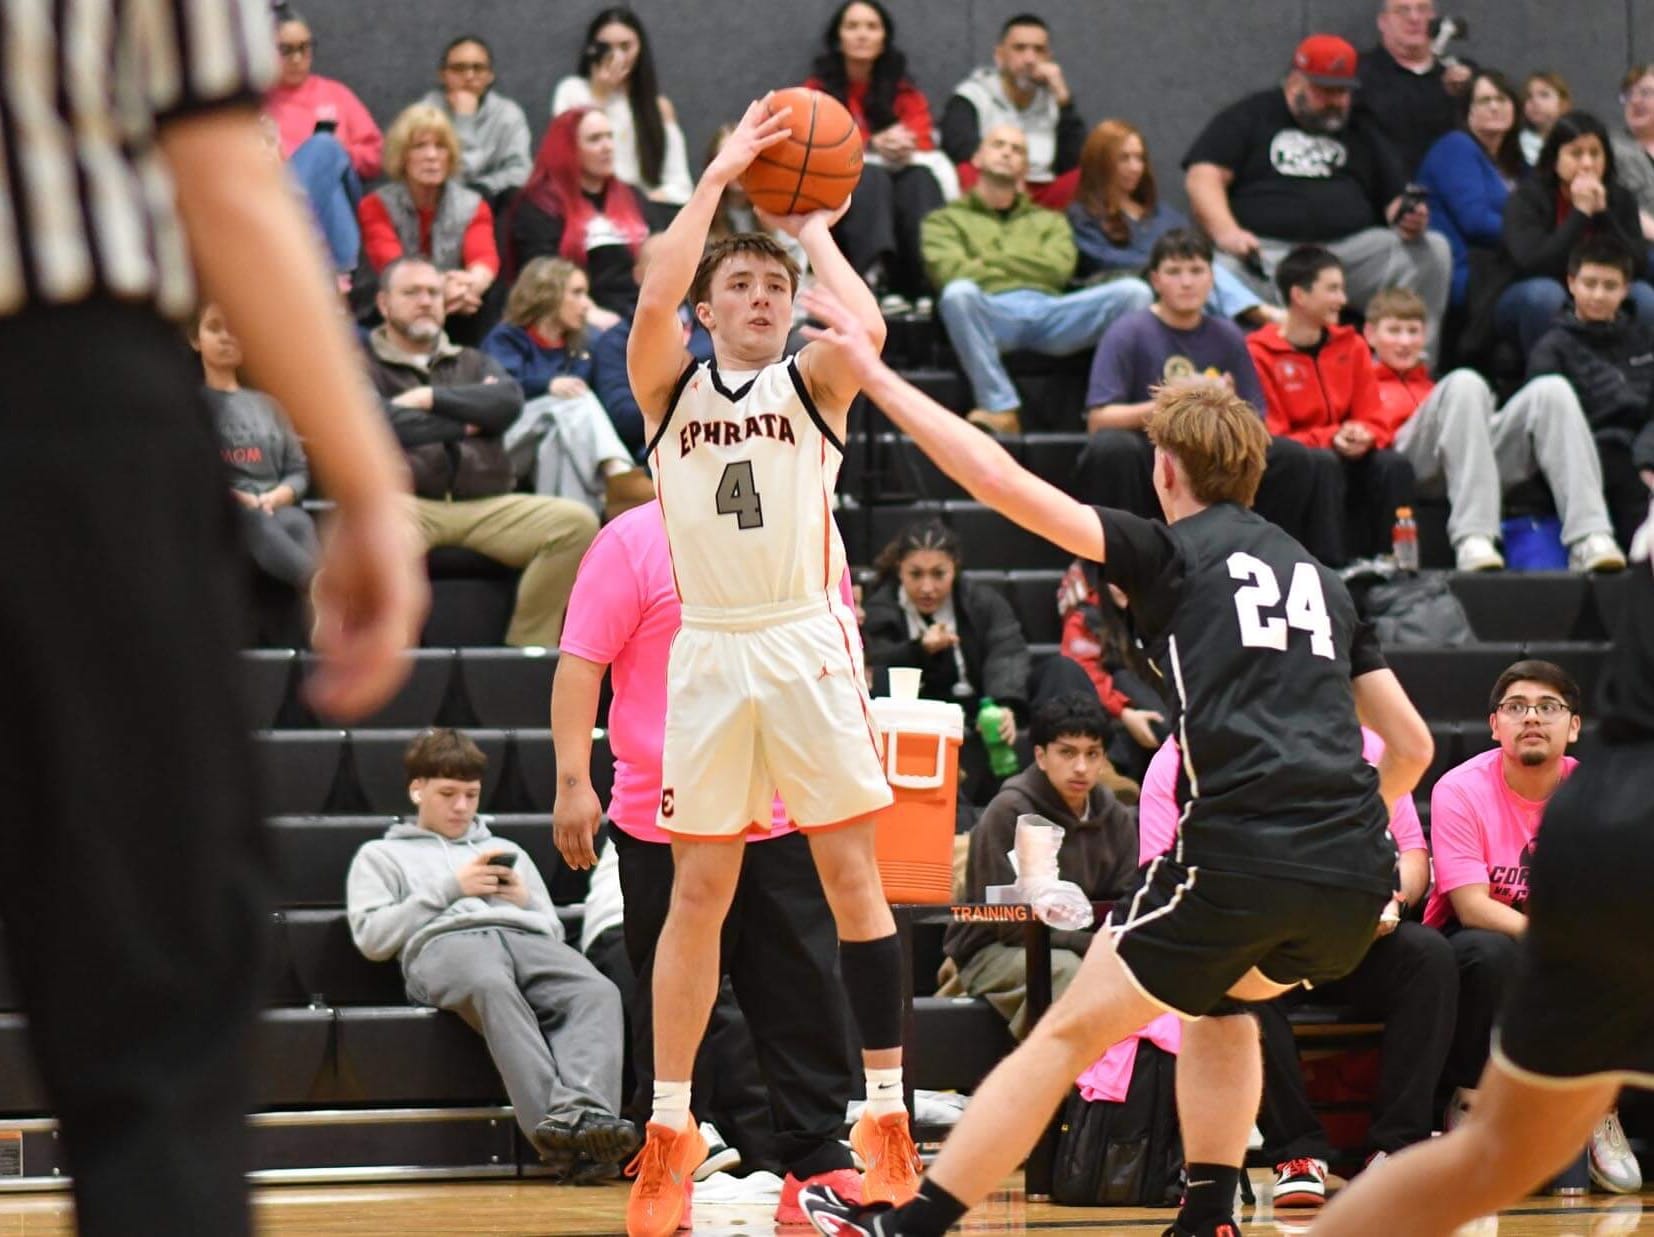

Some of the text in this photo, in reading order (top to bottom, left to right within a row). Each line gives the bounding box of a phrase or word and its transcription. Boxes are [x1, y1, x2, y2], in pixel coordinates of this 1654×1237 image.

[679, 413, 796, 459] EPHRATA
[715, 459, 764, 530] 4
[1226, 551, 1336, 660] 24
[950, 905, 1027, 922] TRAINING
